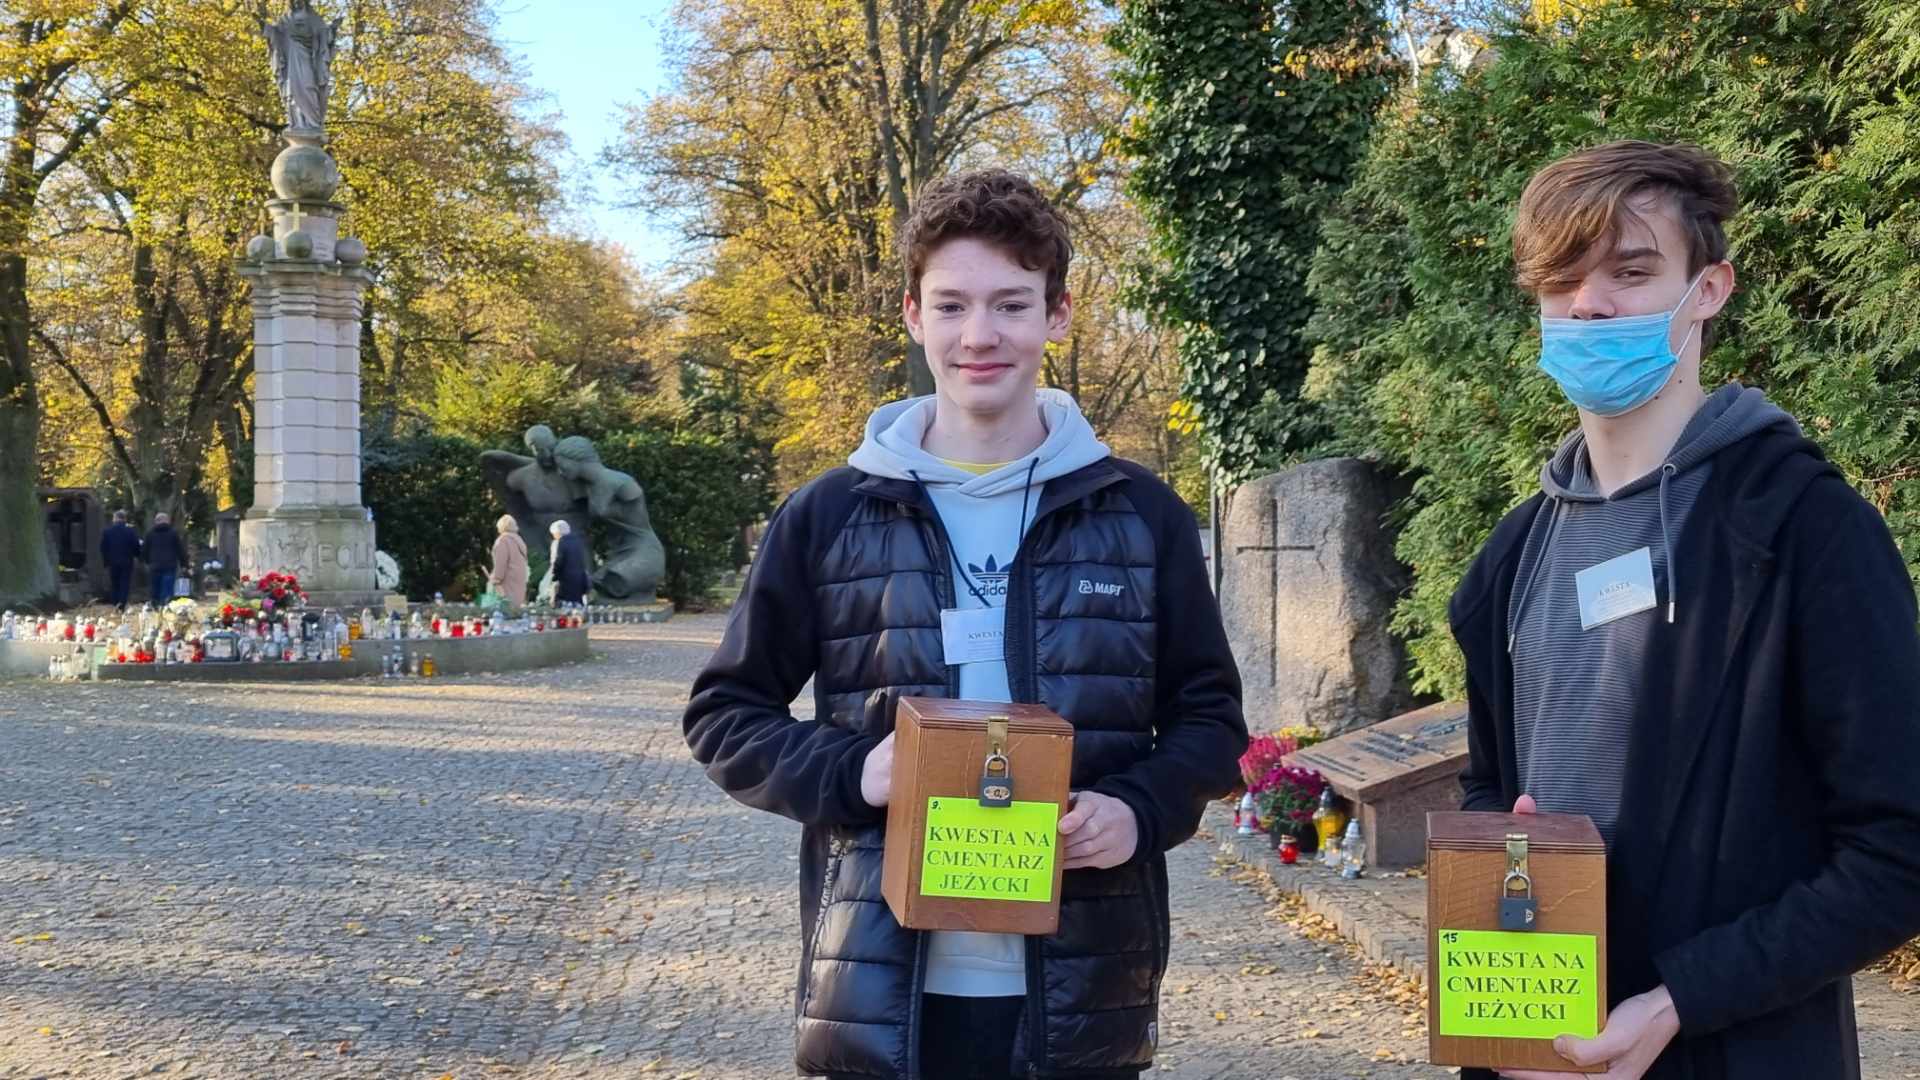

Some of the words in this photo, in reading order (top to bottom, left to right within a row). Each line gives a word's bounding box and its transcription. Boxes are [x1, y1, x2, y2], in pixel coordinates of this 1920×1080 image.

[969, 584, 1007, 596] adida
[929, 826, 1016, 845] KWESTA
[1023, 831, 1050, 847] NA
[927, 849, 1044, 870] CMENTARZ
[939, 872, 1030, 893] JEŻYCKI
[1443, 932, 1459, 944] 15
[1447, 951, 1545, 969] KWESTA
[1553, 953, 1585, 970] NA
[1447, 976, 1581, 995] CMENTARZ
[1464, 998, 1566, 1020] JEŻYCKI
